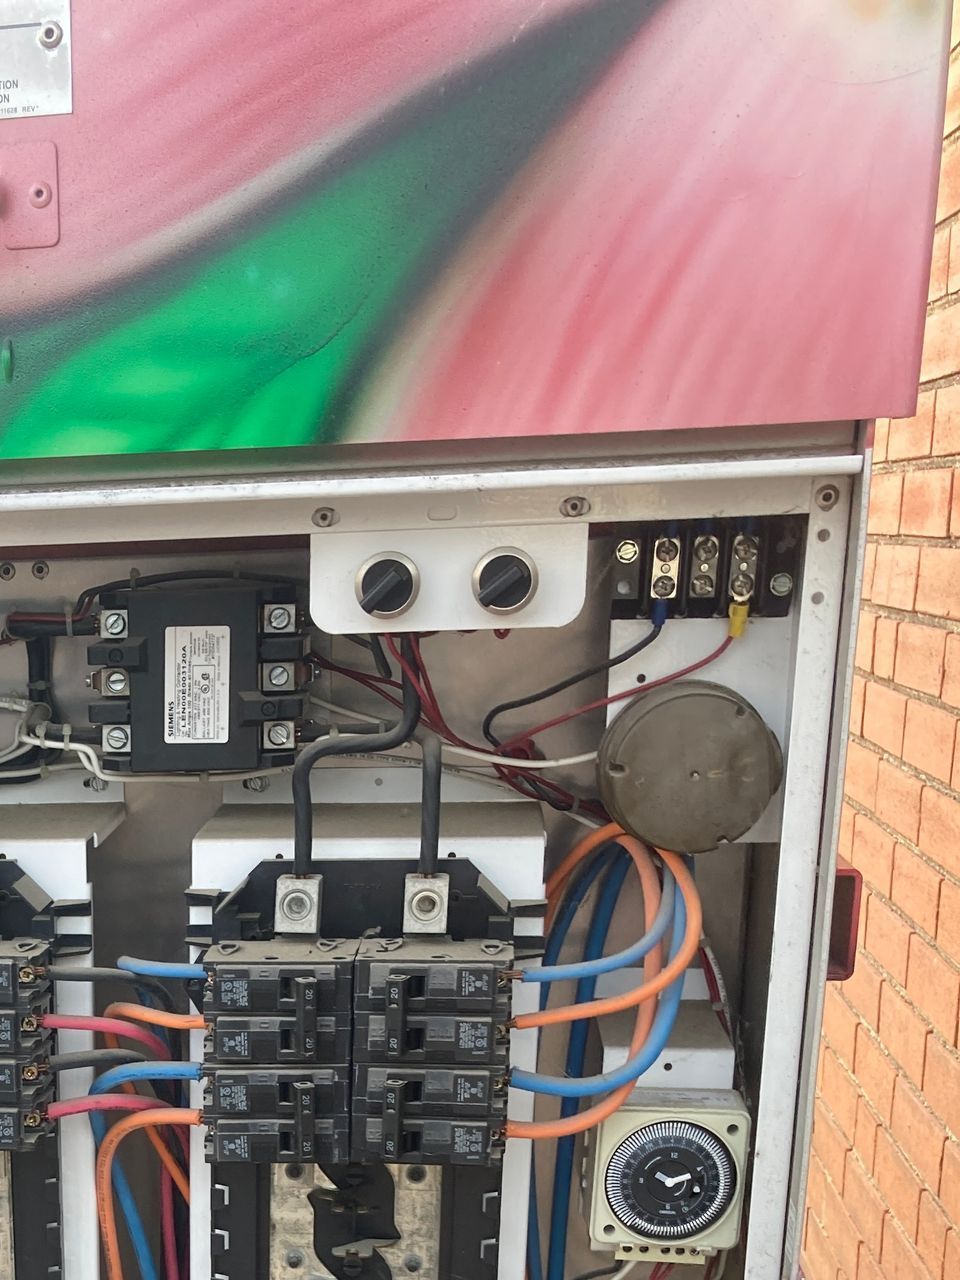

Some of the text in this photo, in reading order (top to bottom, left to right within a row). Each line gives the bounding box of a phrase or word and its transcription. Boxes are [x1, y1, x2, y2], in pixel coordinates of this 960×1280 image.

[167, 701, 175, 737] SIEMENS
[305, 989, 313, 1000] 20
[391, 987, 399, 999] 20
[390, 1037, 397, 1049] 20
[302, 1094, 310, 1105] 20
[387, 1092, 395, 1104] 20
[303, 1141, 311, 1152] 20
[386, 1140, 394, 1151] 20
